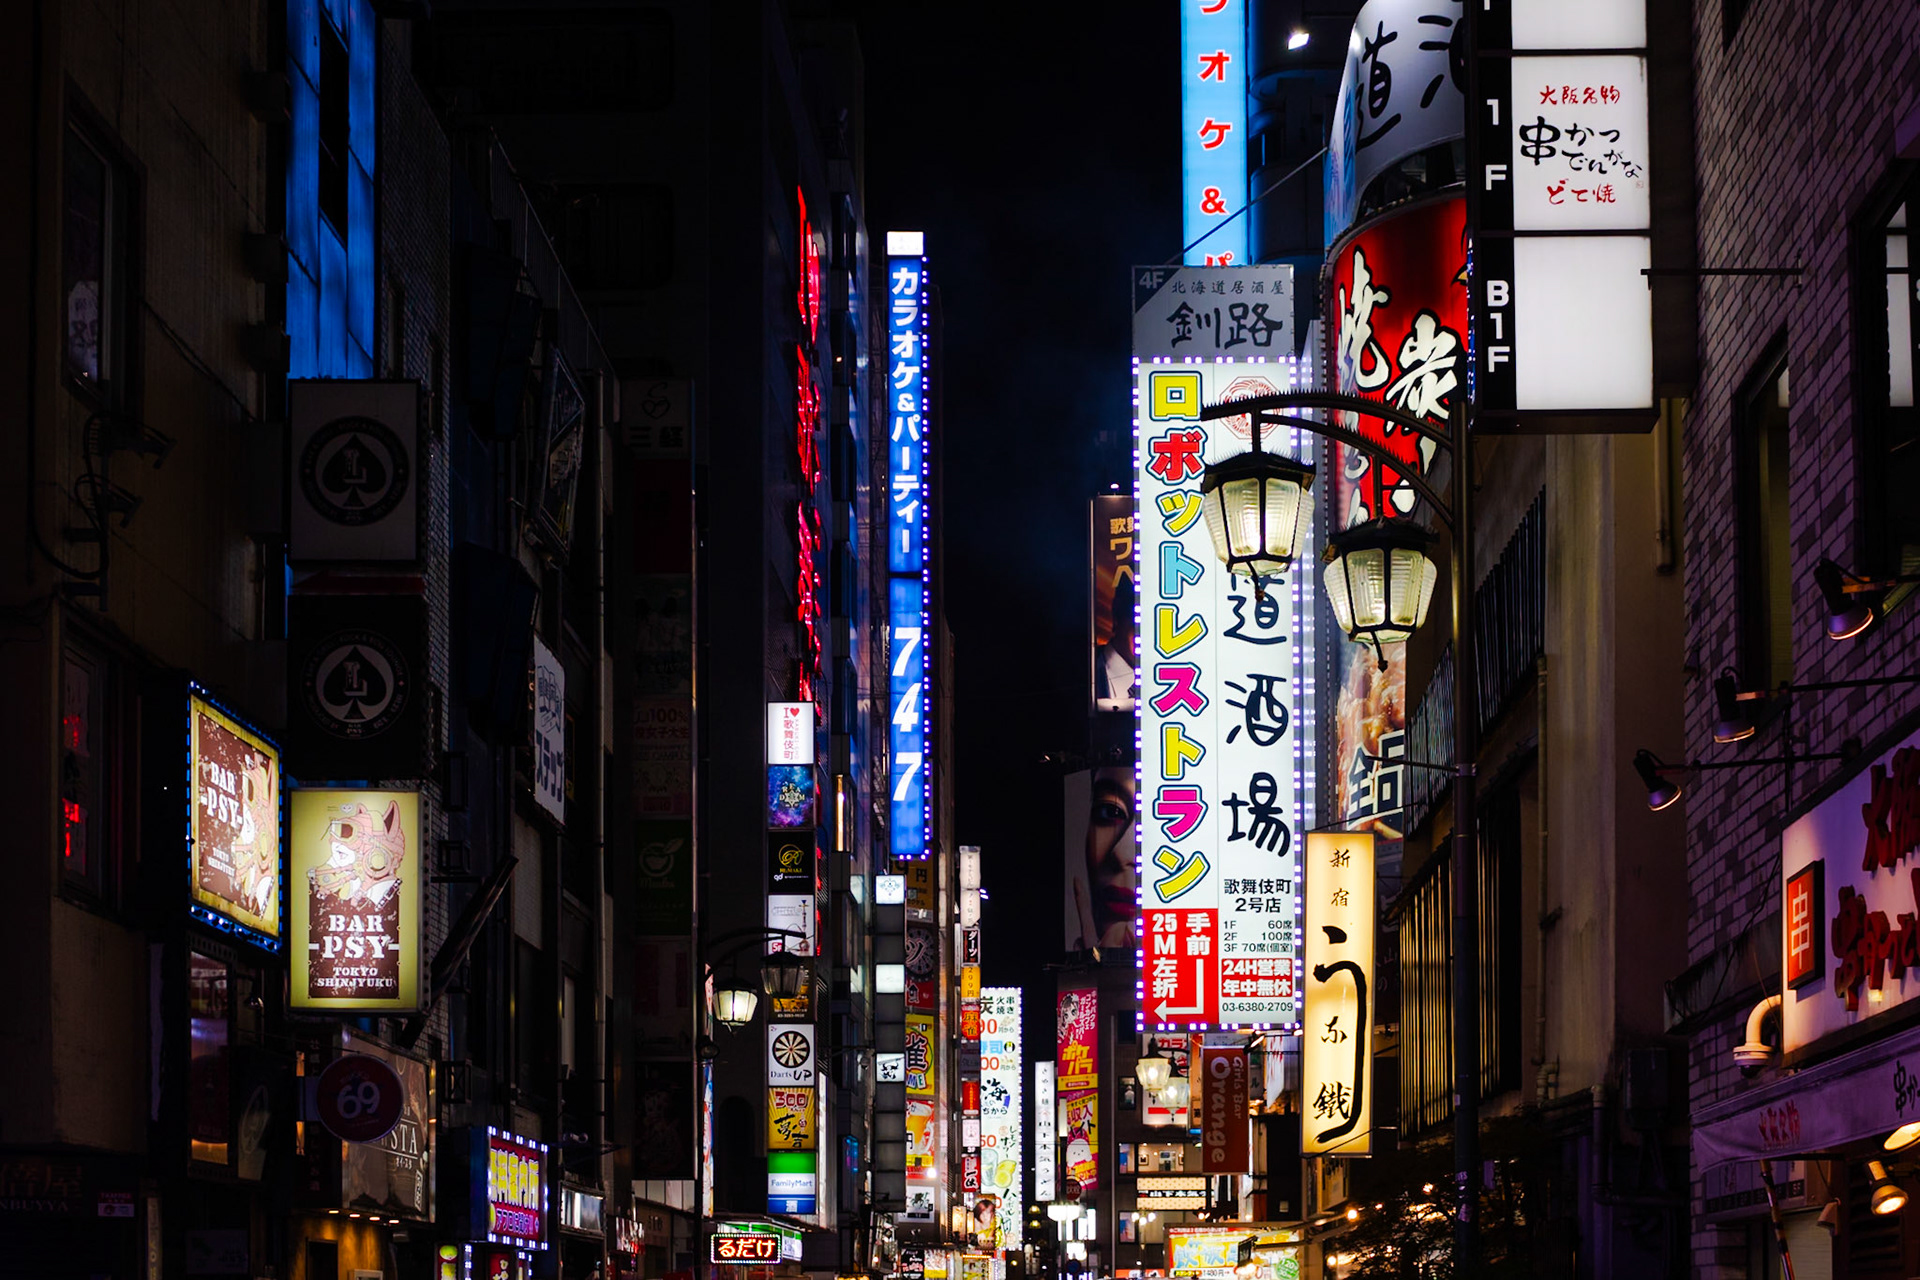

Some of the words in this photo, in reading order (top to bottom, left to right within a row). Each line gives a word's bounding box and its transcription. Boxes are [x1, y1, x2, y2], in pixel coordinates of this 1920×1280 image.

[1539, 85, 1620, 105] 大阪名物
[1519, 116, 1620, 166] 串かつ
[1561, 149, 1643, 179] でんがな
[1139, 271, 1165, 289] 4F
[1172, 280, 1285, 295] 北海道居酒屋
[1166, 301, 1283, 350] 釧路
[891, 267, 920, 553] カラオケ&パーティー
[1146, 371, 1210, 902] ロボットレストラン
[784, 707, 789, 719] I
[892, 627, 922, 801] 747
[211, 761, 235, 795] BAR
[207, 786, 240, 829] PSY
[1224, 879, 1292, 895] 歌舞伎町
[1328, 847, 1351, 907] 新宿
[1235, 897, 1282, 913] 2号店
[328, 914, 384, 932] BAR
[1224, 921, 1237, 929] 1F
[1268, 920, 1293, 930] 60席
[968, 930, 978, 957] ダーツ
[1186, 913, 1211, 956] 手前
[1224, 932, 1238, 941] 2F
[1261, 931, 1293, 941] 100席
[322, 935, 391, 958] PSY
[1224, 943, 1238, 952] 3F
[333, 966, 378, 976] TOKYO
[1223, 959, 1292, 977] 24H営業
[317, 978, 393, 988] SHINJYUKU
[1223, 978, 1292, 997] 年中無休
[1222, 1002, 1293, 1012] 03-6380-2709
[793, 1069, 812, 1081] UP
[337, 1081, 381, 1120] 69
[1206, 1055, 1231, 1164] Orange
[1067, 1101, 1093, 1124] 収入
[771, 1179, 813, 1188] FamilyMart
[718, 1238, 776, 1258] るだけ
